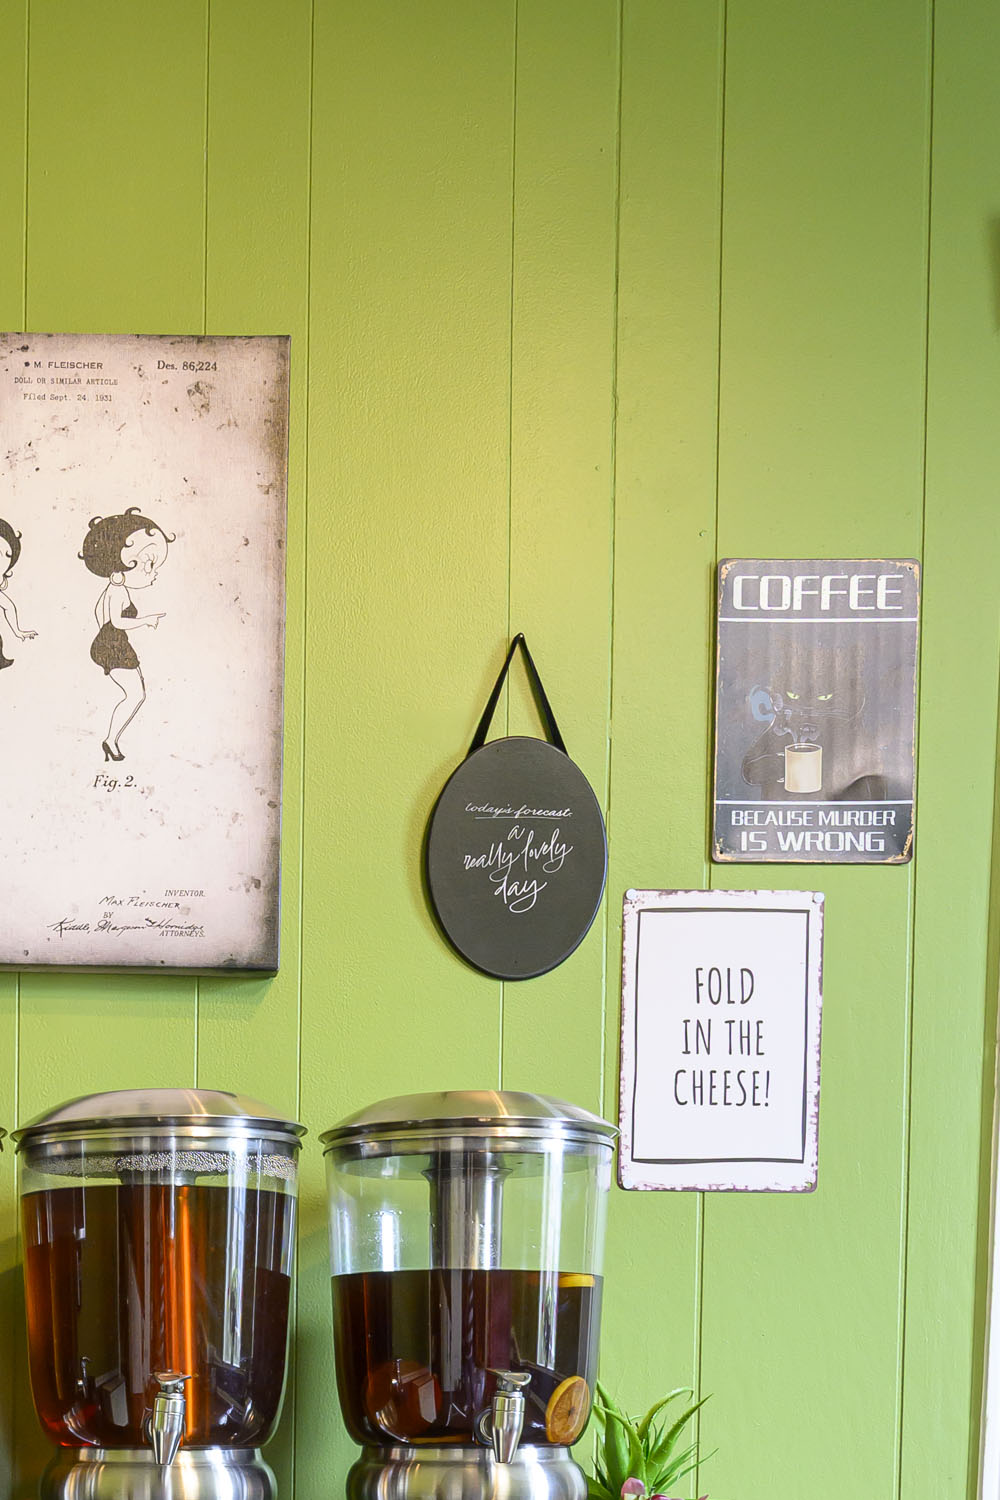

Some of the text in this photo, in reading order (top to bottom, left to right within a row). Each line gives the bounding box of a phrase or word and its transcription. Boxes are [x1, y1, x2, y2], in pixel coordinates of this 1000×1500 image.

[48, 361, 104, 370] FLEISCHER
[157, 360, 218, 373] Des. 86,224
[14, 376, 118, 387] DOLL OR SIMILAR ARTICLE
[23, 393, 46, 401] Filed
[50, 393, 72, 402] Sept.
[95, 394, 113, 402] 1931
[732, 574, 904, 612] COFFEE
[93, 774, 138, 792] Fig. 2.
[465, 802, 514, 819] today's
[731, 809, 897, 827] BECAUSE MURDER
[507, 825, 526, 841] a
[741, 831, 886, 853] IS WRONG
[463, 828, 574, 883] really lovely
[164, 889, 206, 898] INVENTOR.
[493, 875, 548, 914] day
[103, 911, 114, 919] BY
[158, 930, 206, 938] ATTORNEYS.
[695, 967, 755, 1005] FOLD
[681, 1018, 766, 1056] IN THE
[673, 1069, 771, 1108] CHEESE!
